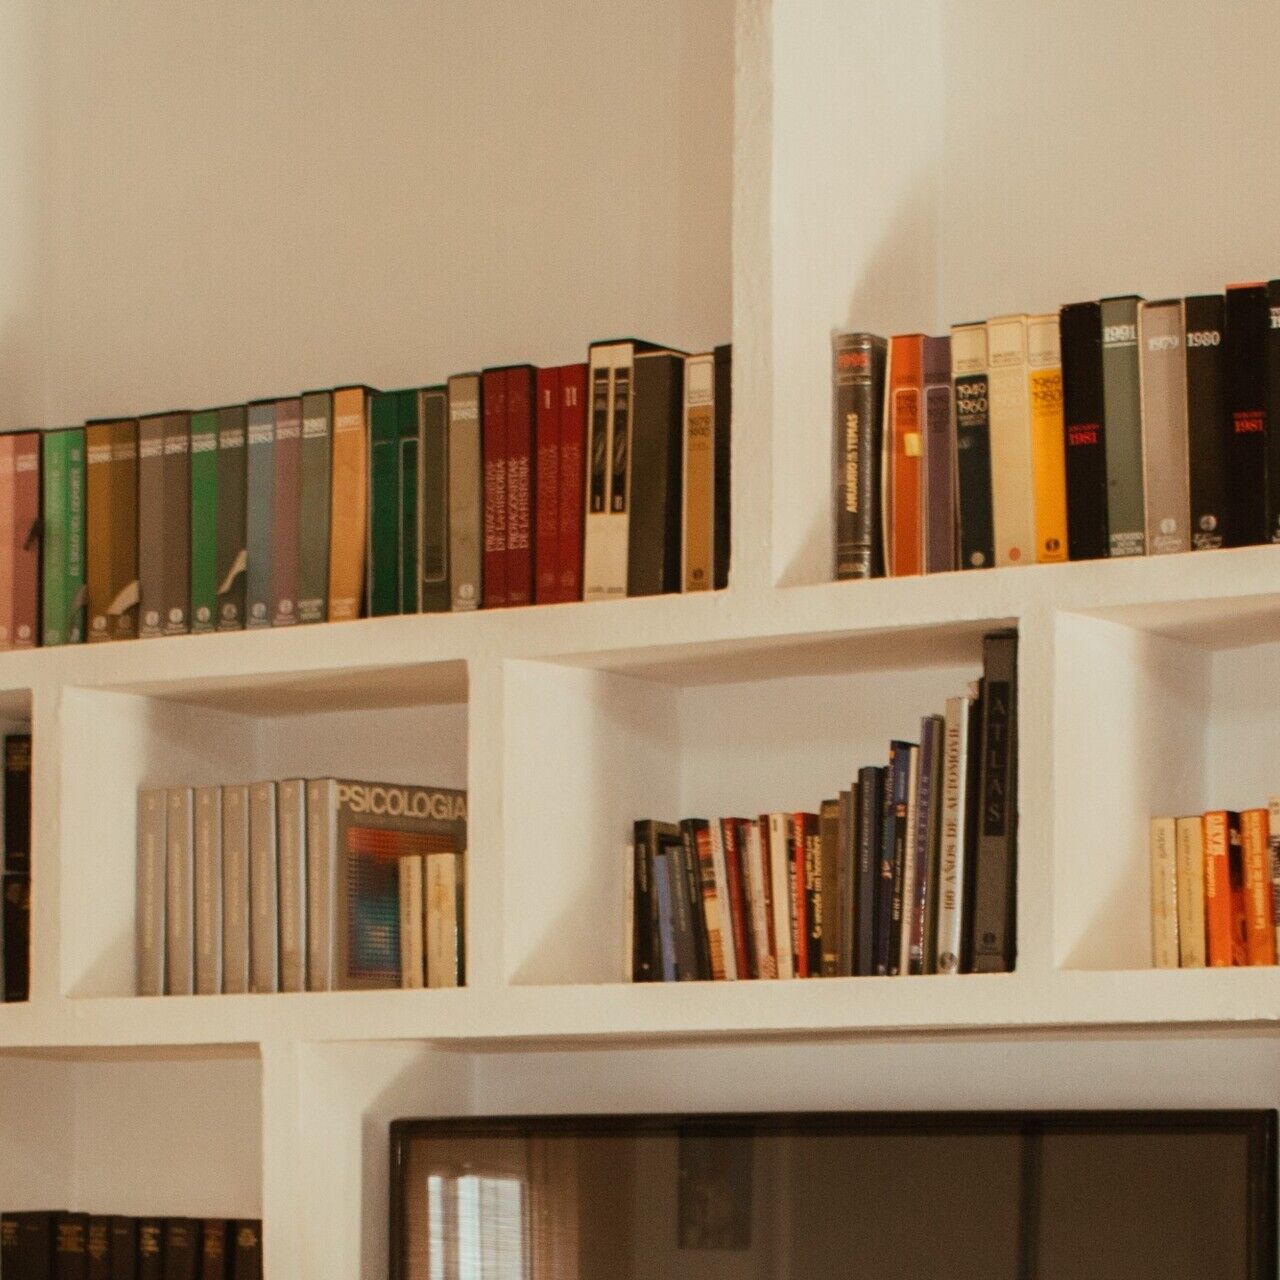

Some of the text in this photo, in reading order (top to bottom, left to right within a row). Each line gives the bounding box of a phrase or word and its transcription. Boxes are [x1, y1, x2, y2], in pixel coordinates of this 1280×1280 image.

[1187, 331, 1220, 347] 1980
[945, 817, 957, 838] DE
[945, 844, 957, 884] AÑOS
